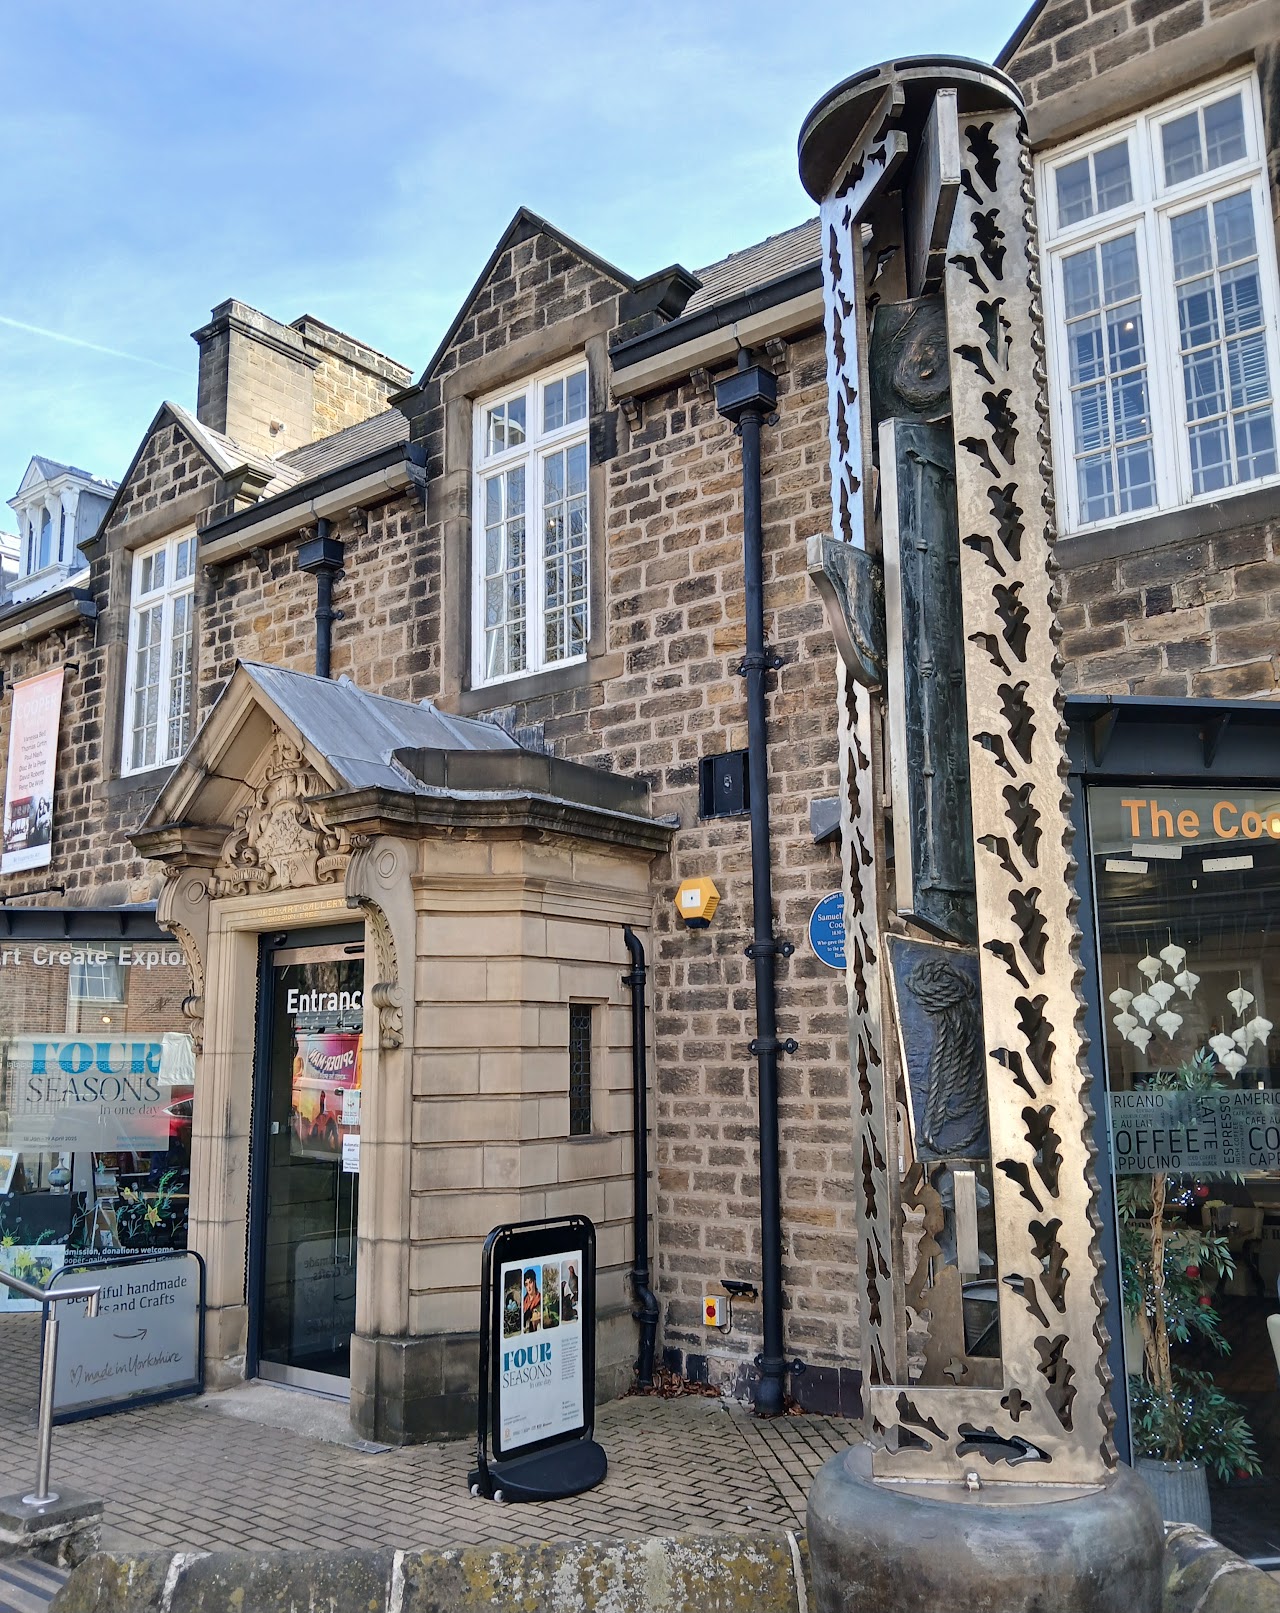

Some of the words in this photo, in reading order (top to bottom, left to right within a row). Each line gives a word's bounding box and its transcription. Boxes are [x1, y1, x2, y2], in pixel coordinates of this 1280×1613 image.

[1121, 800, 1200, 838] The
[1212, 800, 1280, 840] Coo
[280, 904, 298, 914] ART
[302, 899, 345, 910] GALLERY
[818, 912, 842, 921] Samuel
[0, 947, 21, 966] rt
[33, 946, 107, 966] Create
[287, 989, 364, 1014] Entranc
[31, 1042, 163, 1075] FOUR
[26, 1076, 160, 1102] SEASONS
[1111, 1094, 1164, 1108] RICANO
[100, 1104, 111, 1114] In
[114, 1106, 136, 1114] one
[138, 1104, 160, 1117] day
[1201, 1096, 1218, 1150] LATTE
[1246, 1116, 1266, 1125] CAFE
[1121, 1120, 1132, 1128] AU
[1136, 1119, 1153, 1128] LAIT
[1220, 1096, 1234, 1164] ESPRESSO
[1115, 1129, 1199, 1155] OFFEE
[62, 1248, 100, 1256] dmission,
[102, 1246, 139, 1255] donations
[67, 1285, 122, 1305] eatiful
[127, 1276, 187, 1295] handmade
[113, 1298, 135, 1312] and
[140, 1293, 174, 1308] Crafts
[85, 1362, 114, 1384] made
[129, 1351, 182, 1376] Yorkshire
[504, 1342, 552, 1372] FOUR
[503, 1362, 552, 1388] SEASONS
